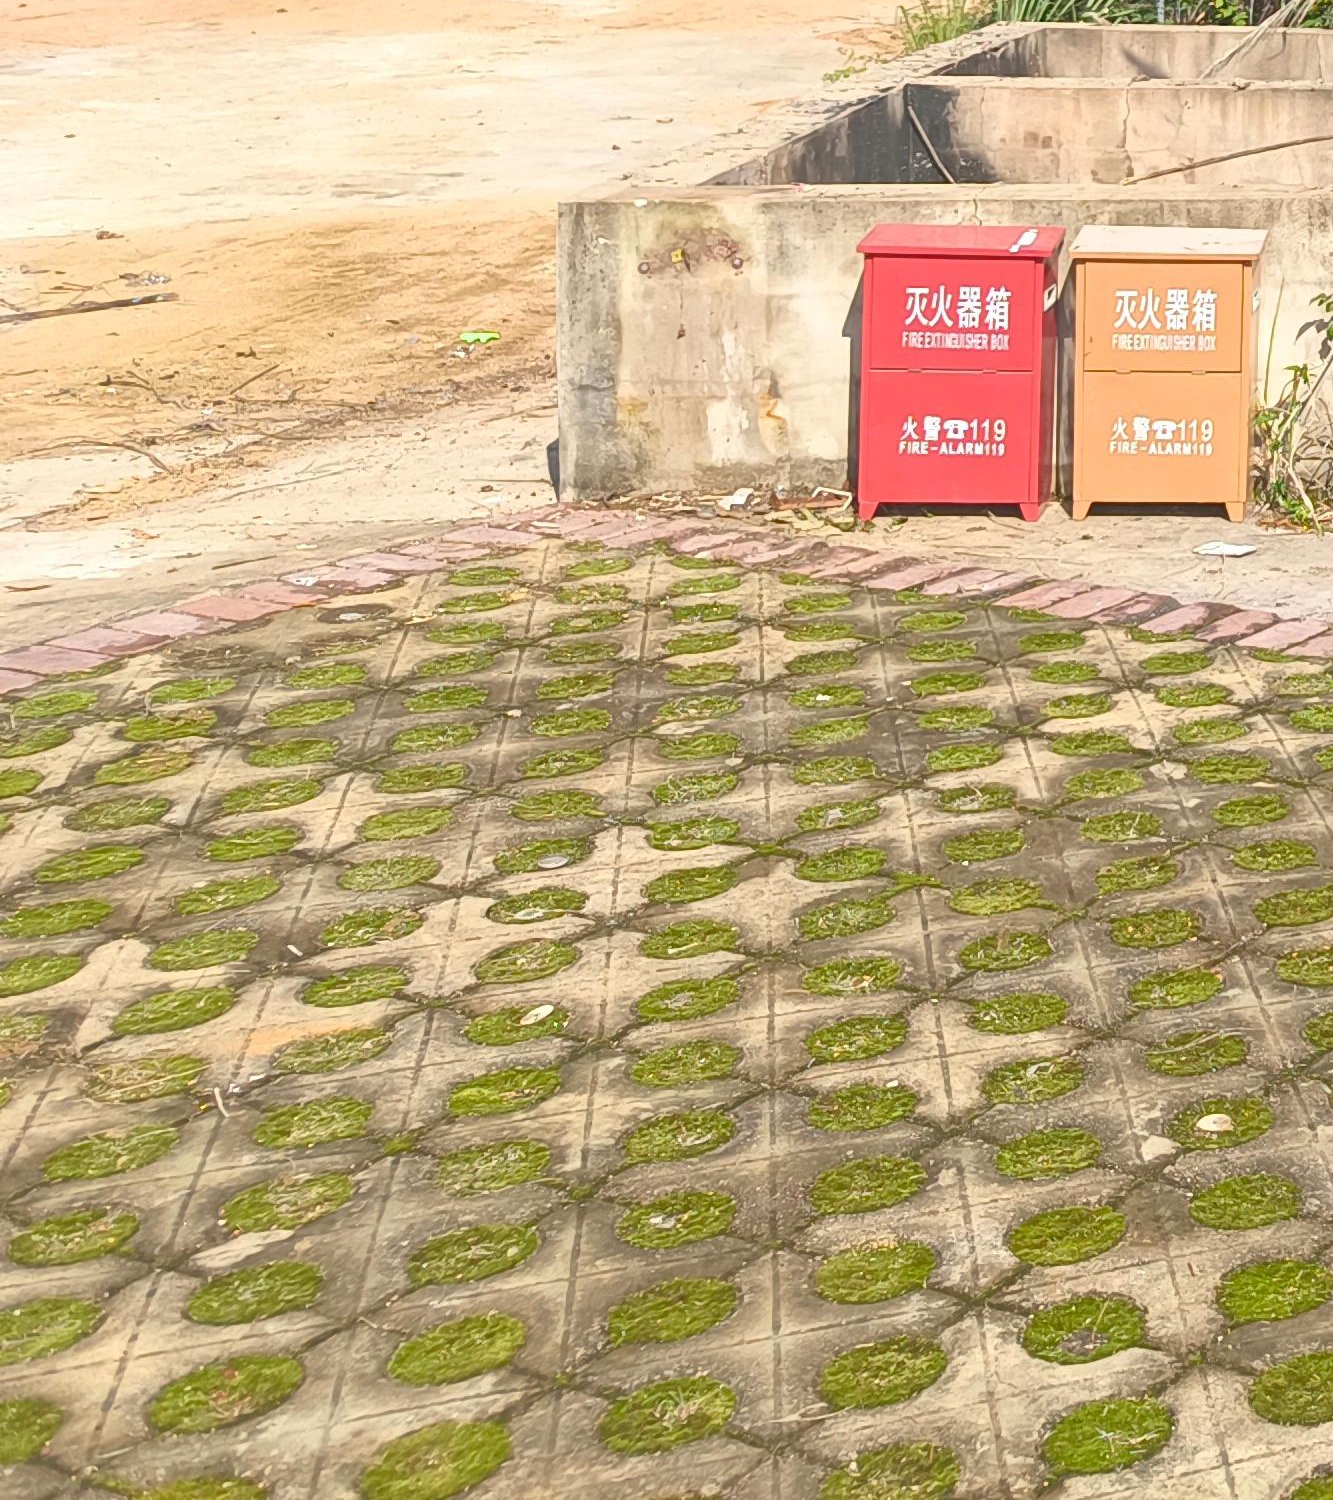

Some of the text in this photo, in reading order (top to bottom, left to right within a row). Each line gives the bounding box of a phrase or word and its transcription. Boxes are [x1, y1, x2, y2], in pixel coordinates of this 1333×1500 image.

[904, 285, 1012, 332] 灭火器箱
[1113, 287, 1218, 333] 灭火器箱
[990, 333, 1010, 350] BOX
[1197, 335, 1217, 351] BOX
[900, 415, 1006, 442] 火警 119
[1111, 416, 1214, 442] 火警 119
